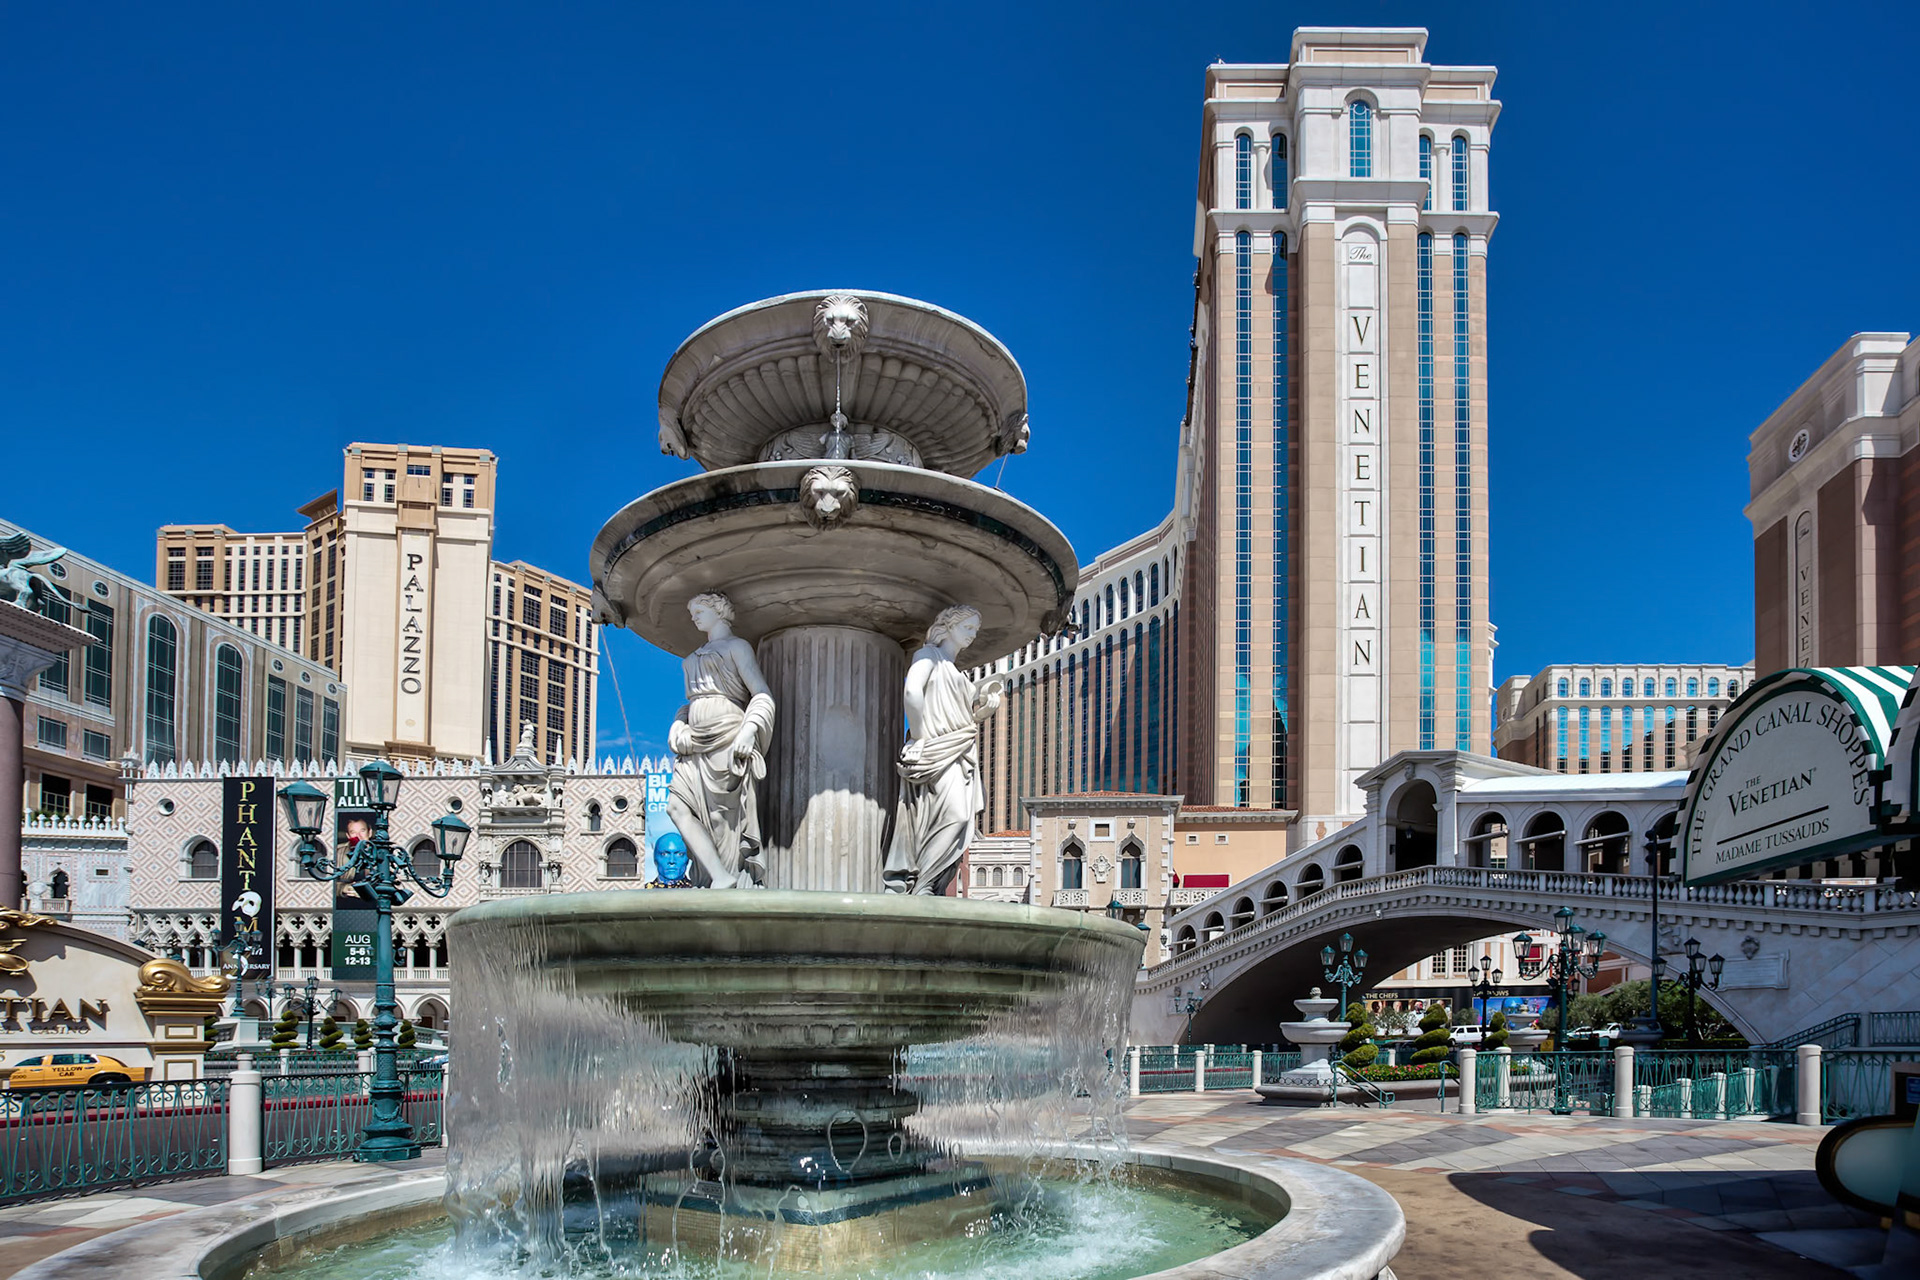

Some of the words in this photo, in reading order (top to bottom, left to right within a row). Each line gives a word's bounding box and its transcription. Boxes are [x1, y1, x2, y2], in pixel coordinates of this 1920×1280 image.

[1350, 246, 1372, 260] The
[1351, 316, 1371, 666] VENETIAN
[401, 553, 424, 694] PALAZZO
[1691, 809, 1706, 861] THE
[1703, 728, 1750, 801] GRAND
[1755, 701, 1813, 737] CANAL
[1816, 703, 1869, 806] SHOPPES
[1745, 775, 1761, 789] THE
[648, 788, 670, 802] M
[1728, 768, 1814, 817] VENETIAN
[1715, 839, 1762, 864] MADAME
[1765, 817, 1829, 850] TUSSAUDS
[345, 934, 371, 944] AUG
[350, 947, 366, 956] 5-6
[345, 956, 371, 966] 12-13
